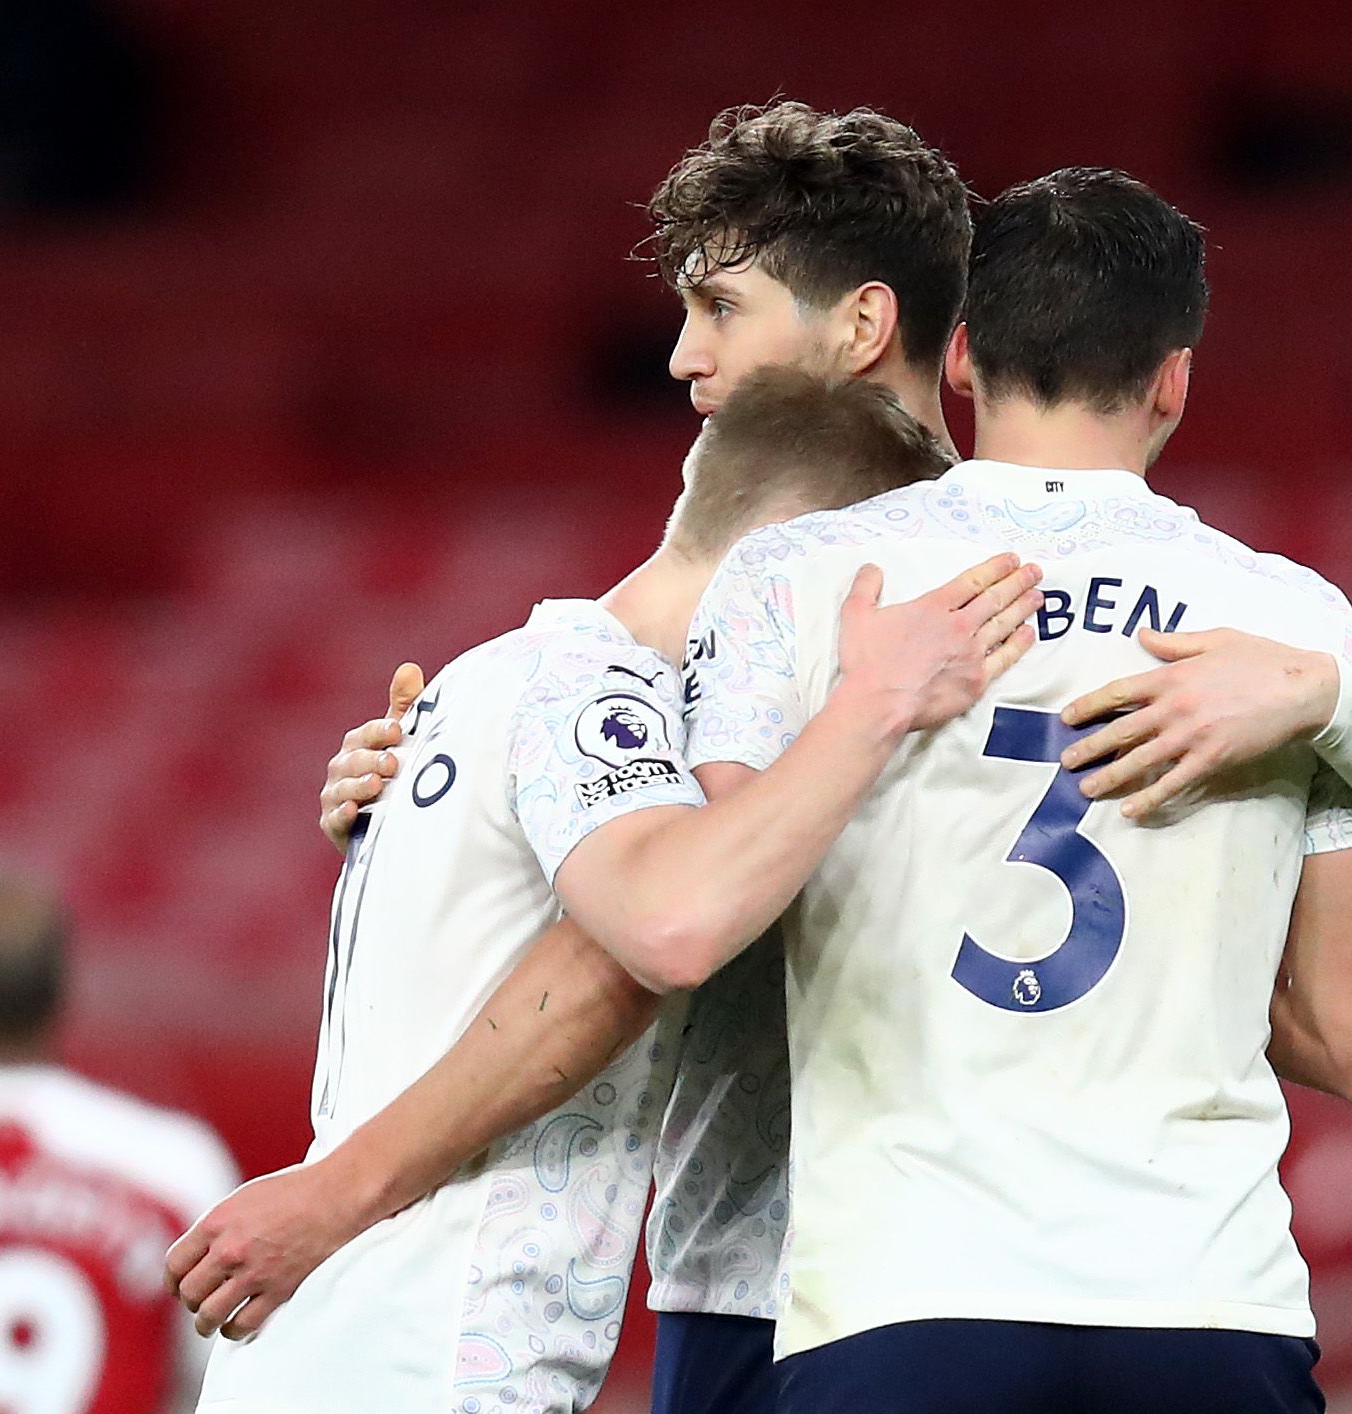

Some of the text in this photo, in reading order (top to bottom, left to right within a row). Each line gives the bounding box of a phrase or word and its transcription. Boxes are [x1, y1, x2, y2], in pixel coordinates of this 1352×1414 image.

[1036, 577, 1188, 642] BEN
[575, 760, 671, 801] No room
[950, 704, 1131, 1018] 3
